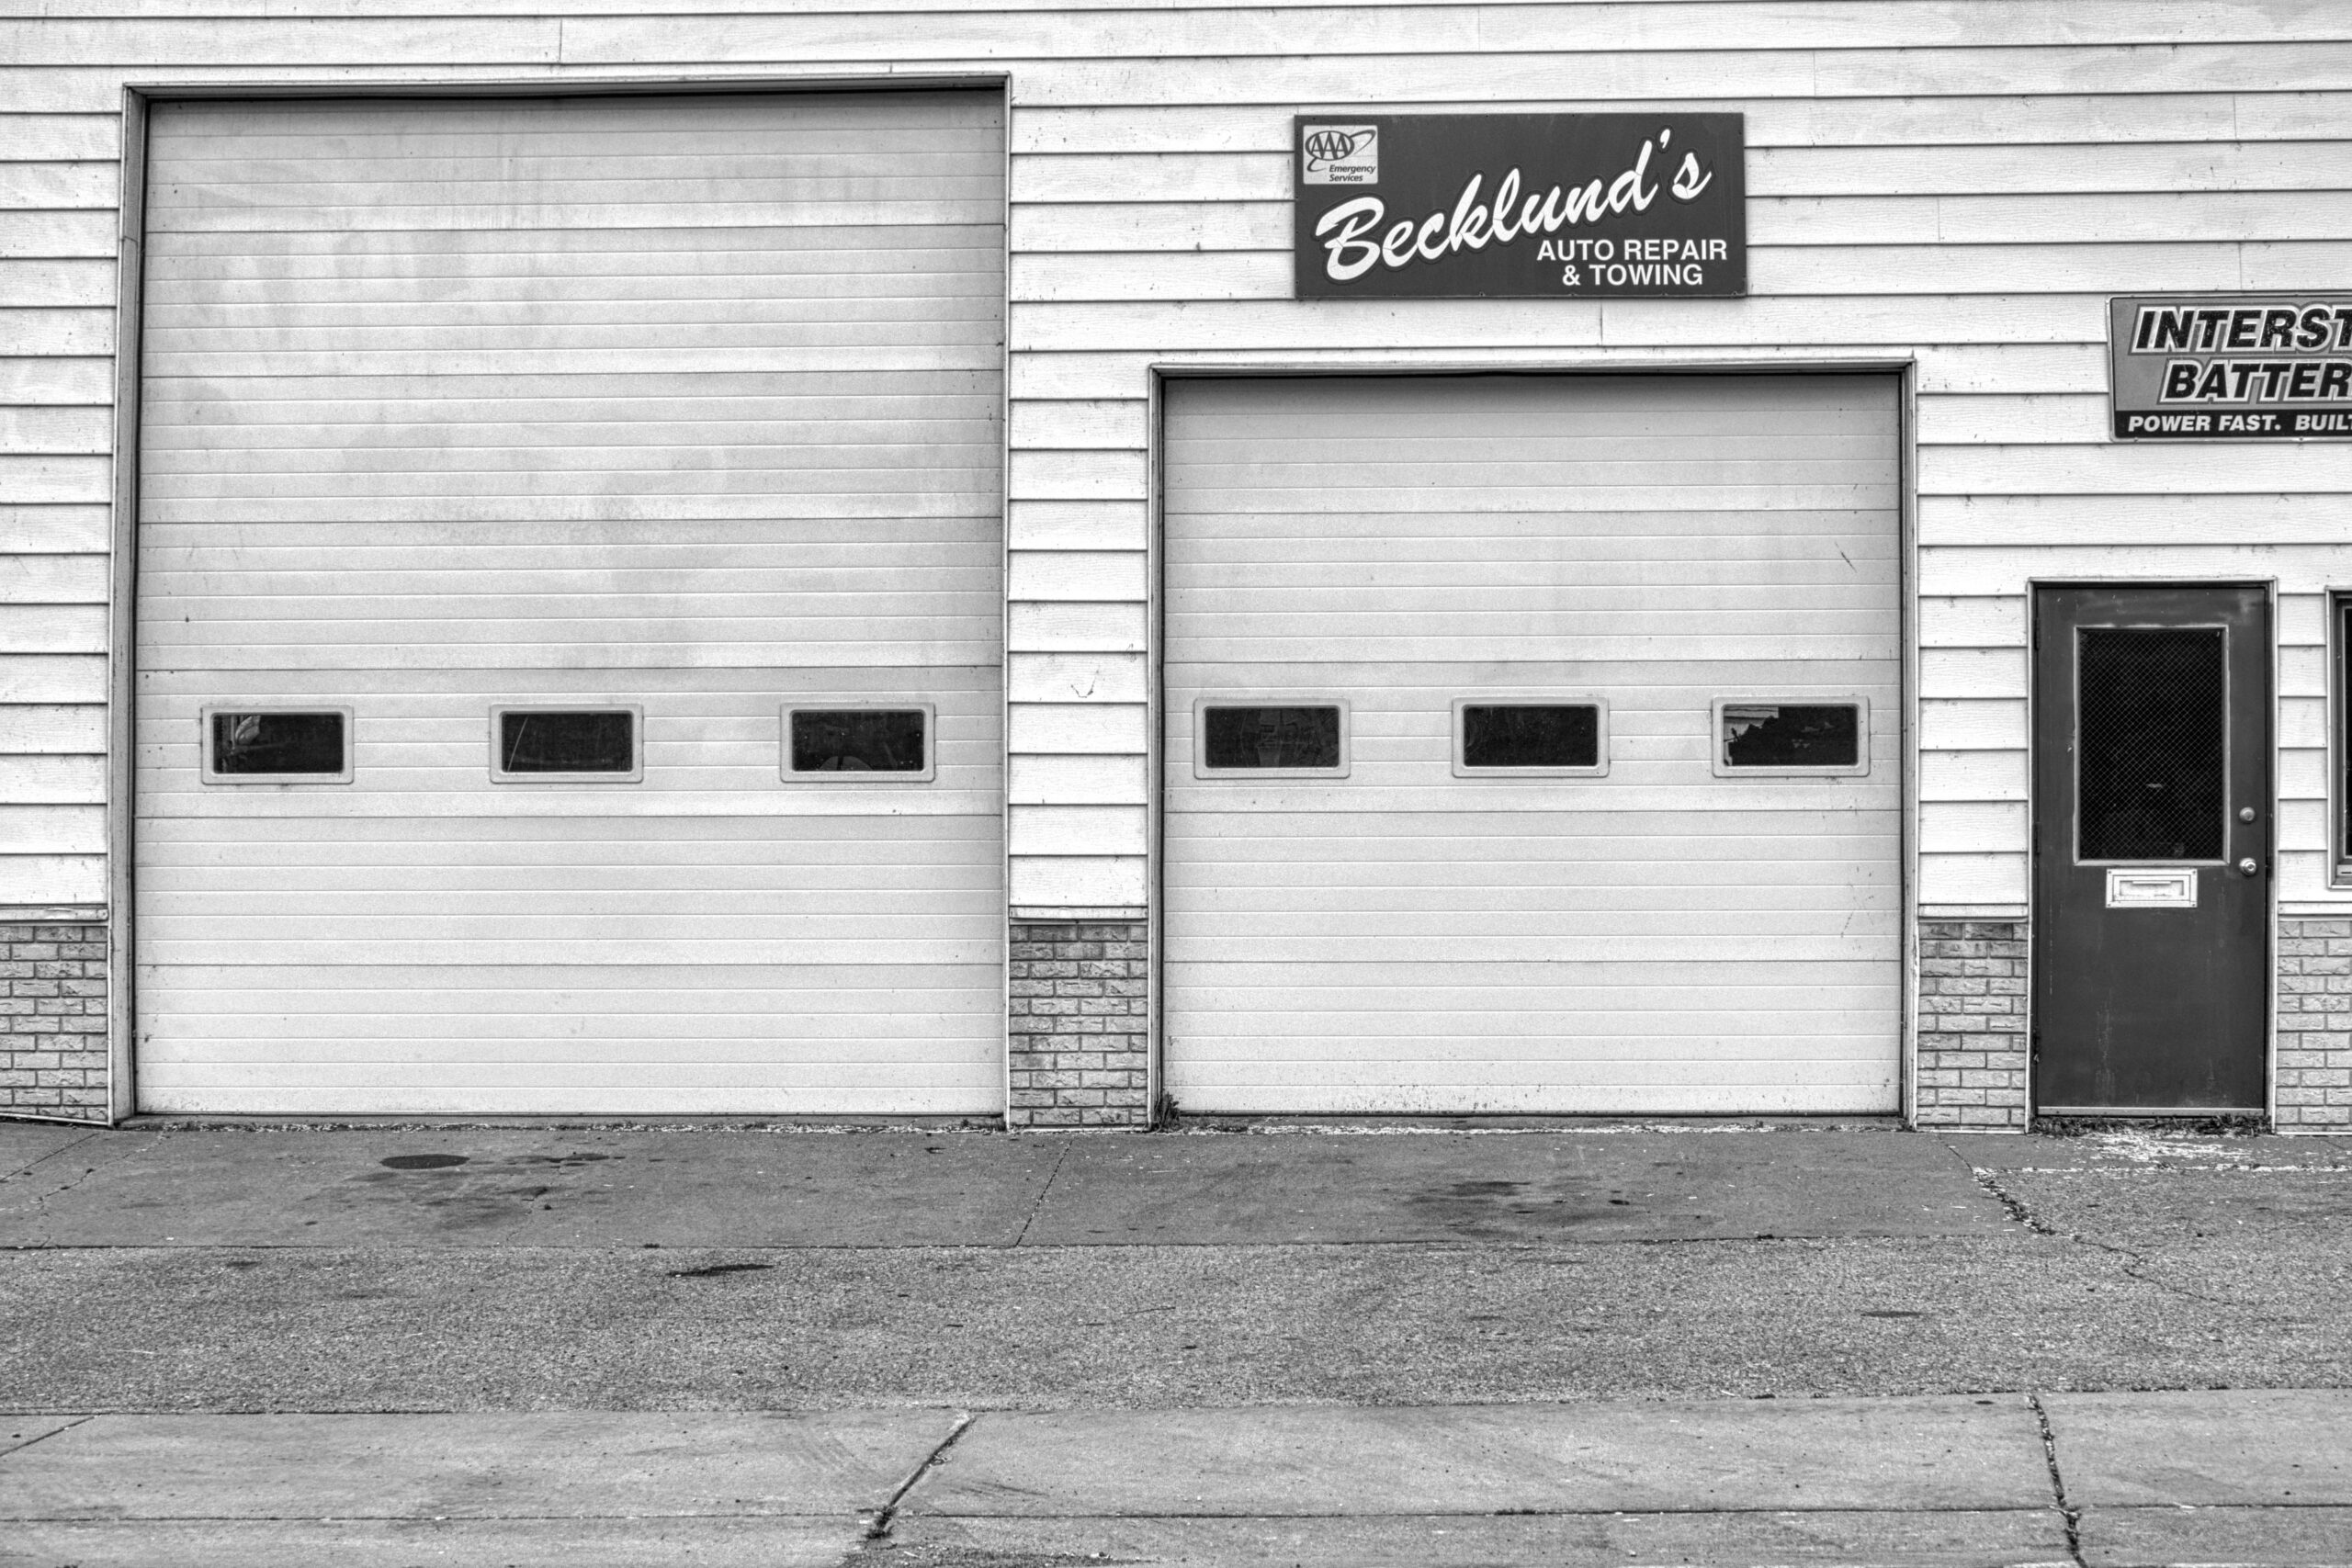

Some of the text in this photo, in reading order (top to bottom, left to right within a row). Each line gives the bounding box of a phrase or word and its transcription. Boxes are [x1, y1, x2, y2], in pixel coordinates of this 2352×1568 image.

[1309, 131, 1351, 160] AAA
[1329, 164, 1376, 175] Emergency
[1329, 174, 1364, 182] Services
[1315, 128, 1713, 281] Becklund's
[1536, 239, 1728, 262] AUTO REPAIR
[1562, 264, 1703, 287] & TOWING
[2162, 361, 2352, 400] BATTER
[2128, 414, 2352, 432] POWER FAST. BUIL
